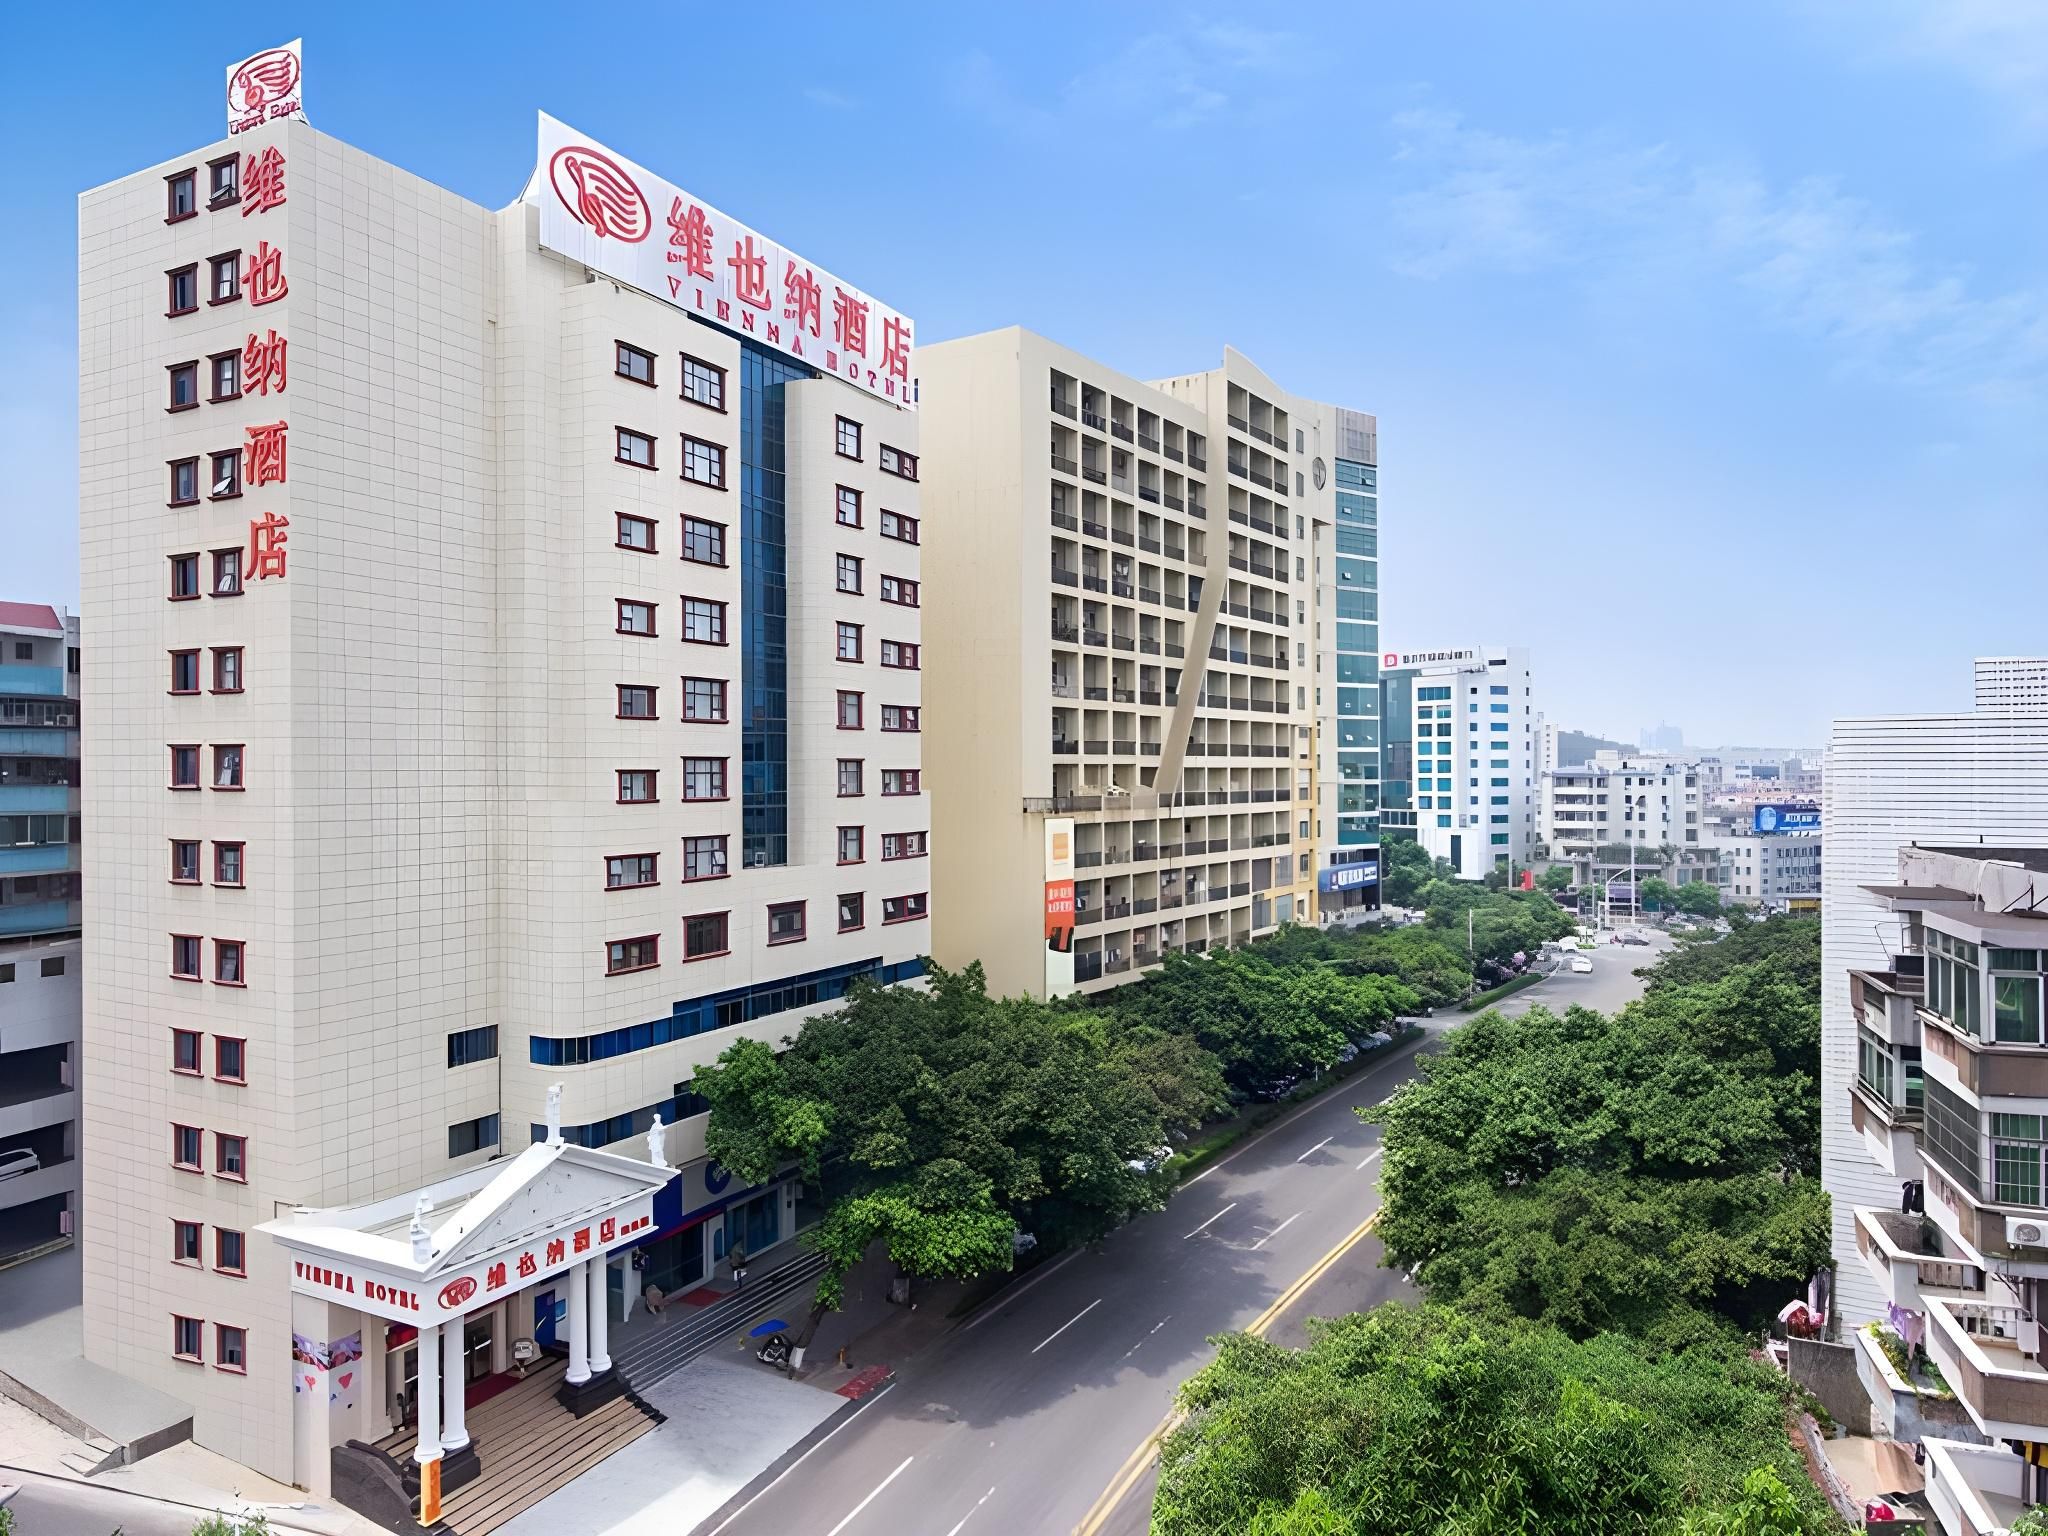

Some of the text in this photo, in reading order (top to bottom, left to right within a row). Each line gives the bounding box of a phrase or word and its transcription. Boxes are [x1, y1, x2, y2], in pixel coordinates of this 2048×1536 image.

[666, 195, 911, 383] 维也纳酒店
[241, 144, 289, 581] 维也纳酒店
[826, 349, 911, 404] OTL
[295, 1261, 355, 1294] VIA
